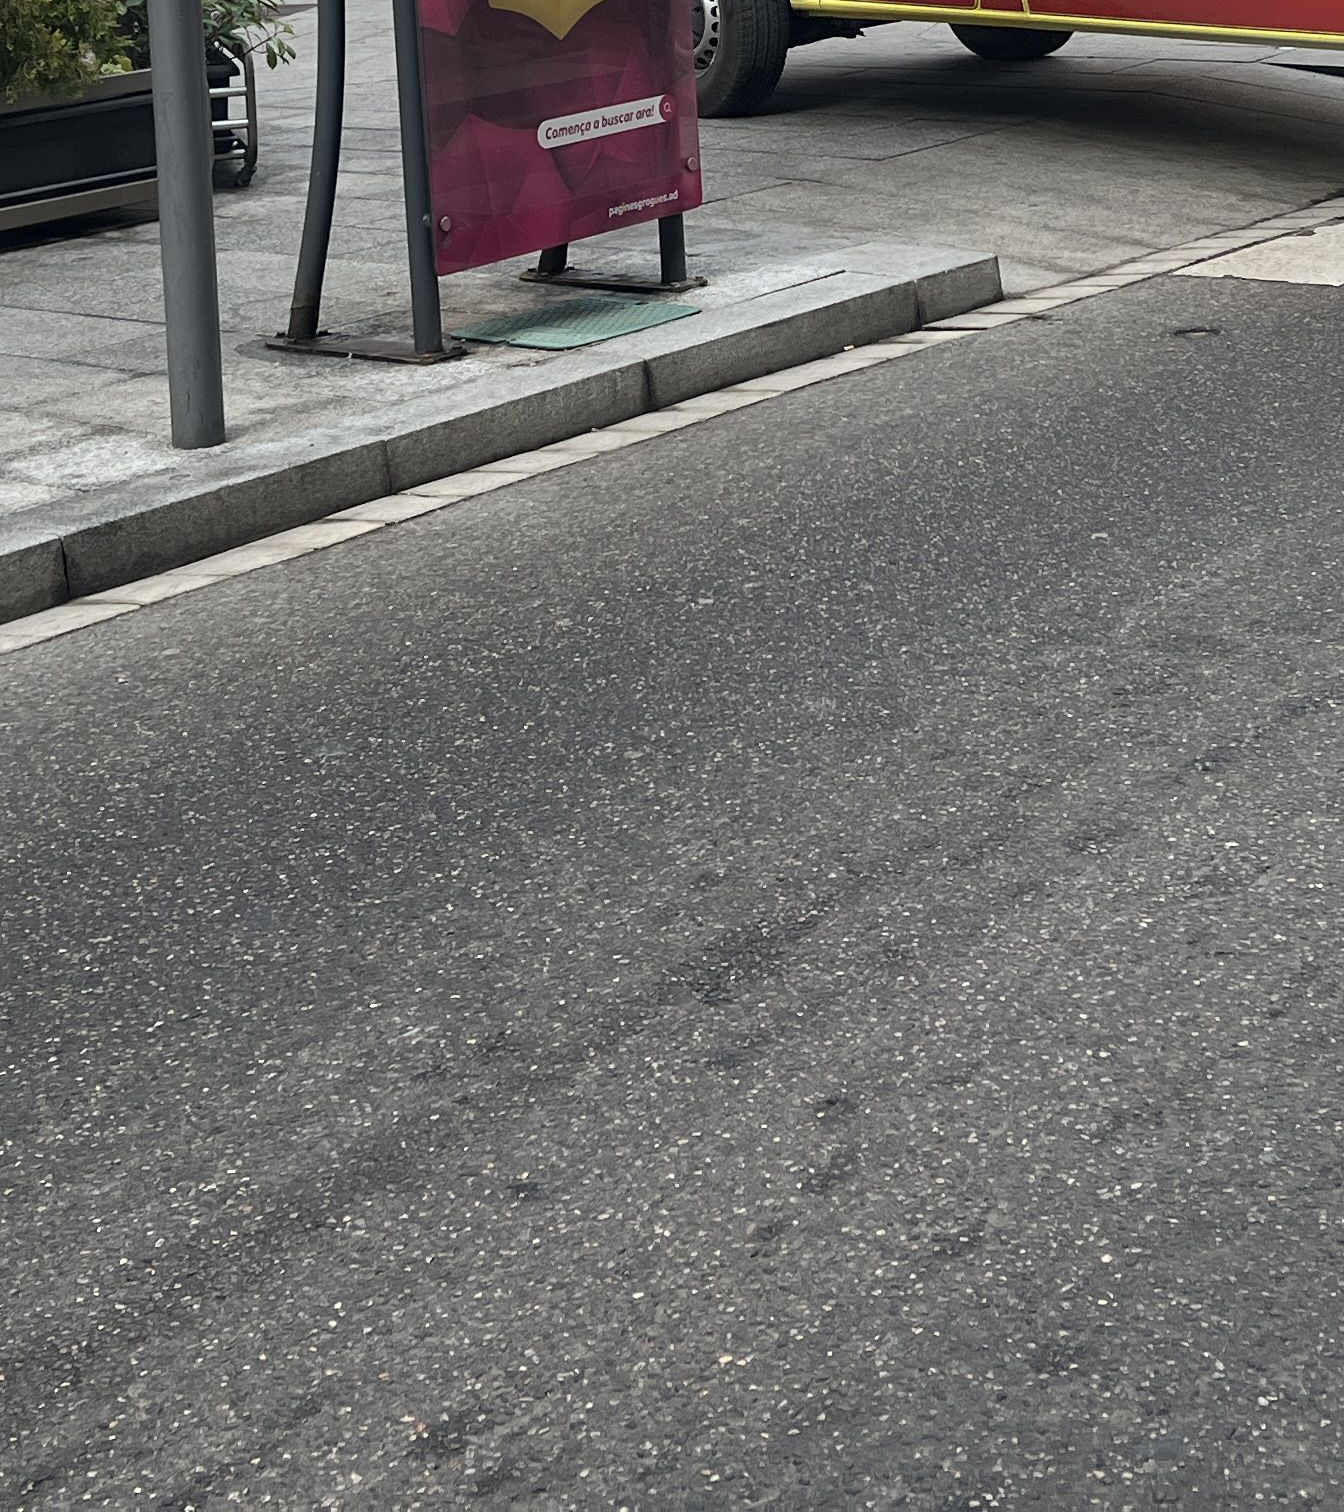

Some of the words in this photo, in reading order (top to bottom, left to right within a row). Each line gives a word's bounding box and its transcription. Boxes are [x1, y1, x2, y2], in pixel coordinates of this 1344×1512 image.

[545, 121, 592, 140] Comença
[593, 120, 600, 130] a
[601, 111, 634, 127] buscar
[635, 104, 656, 120] ara!
